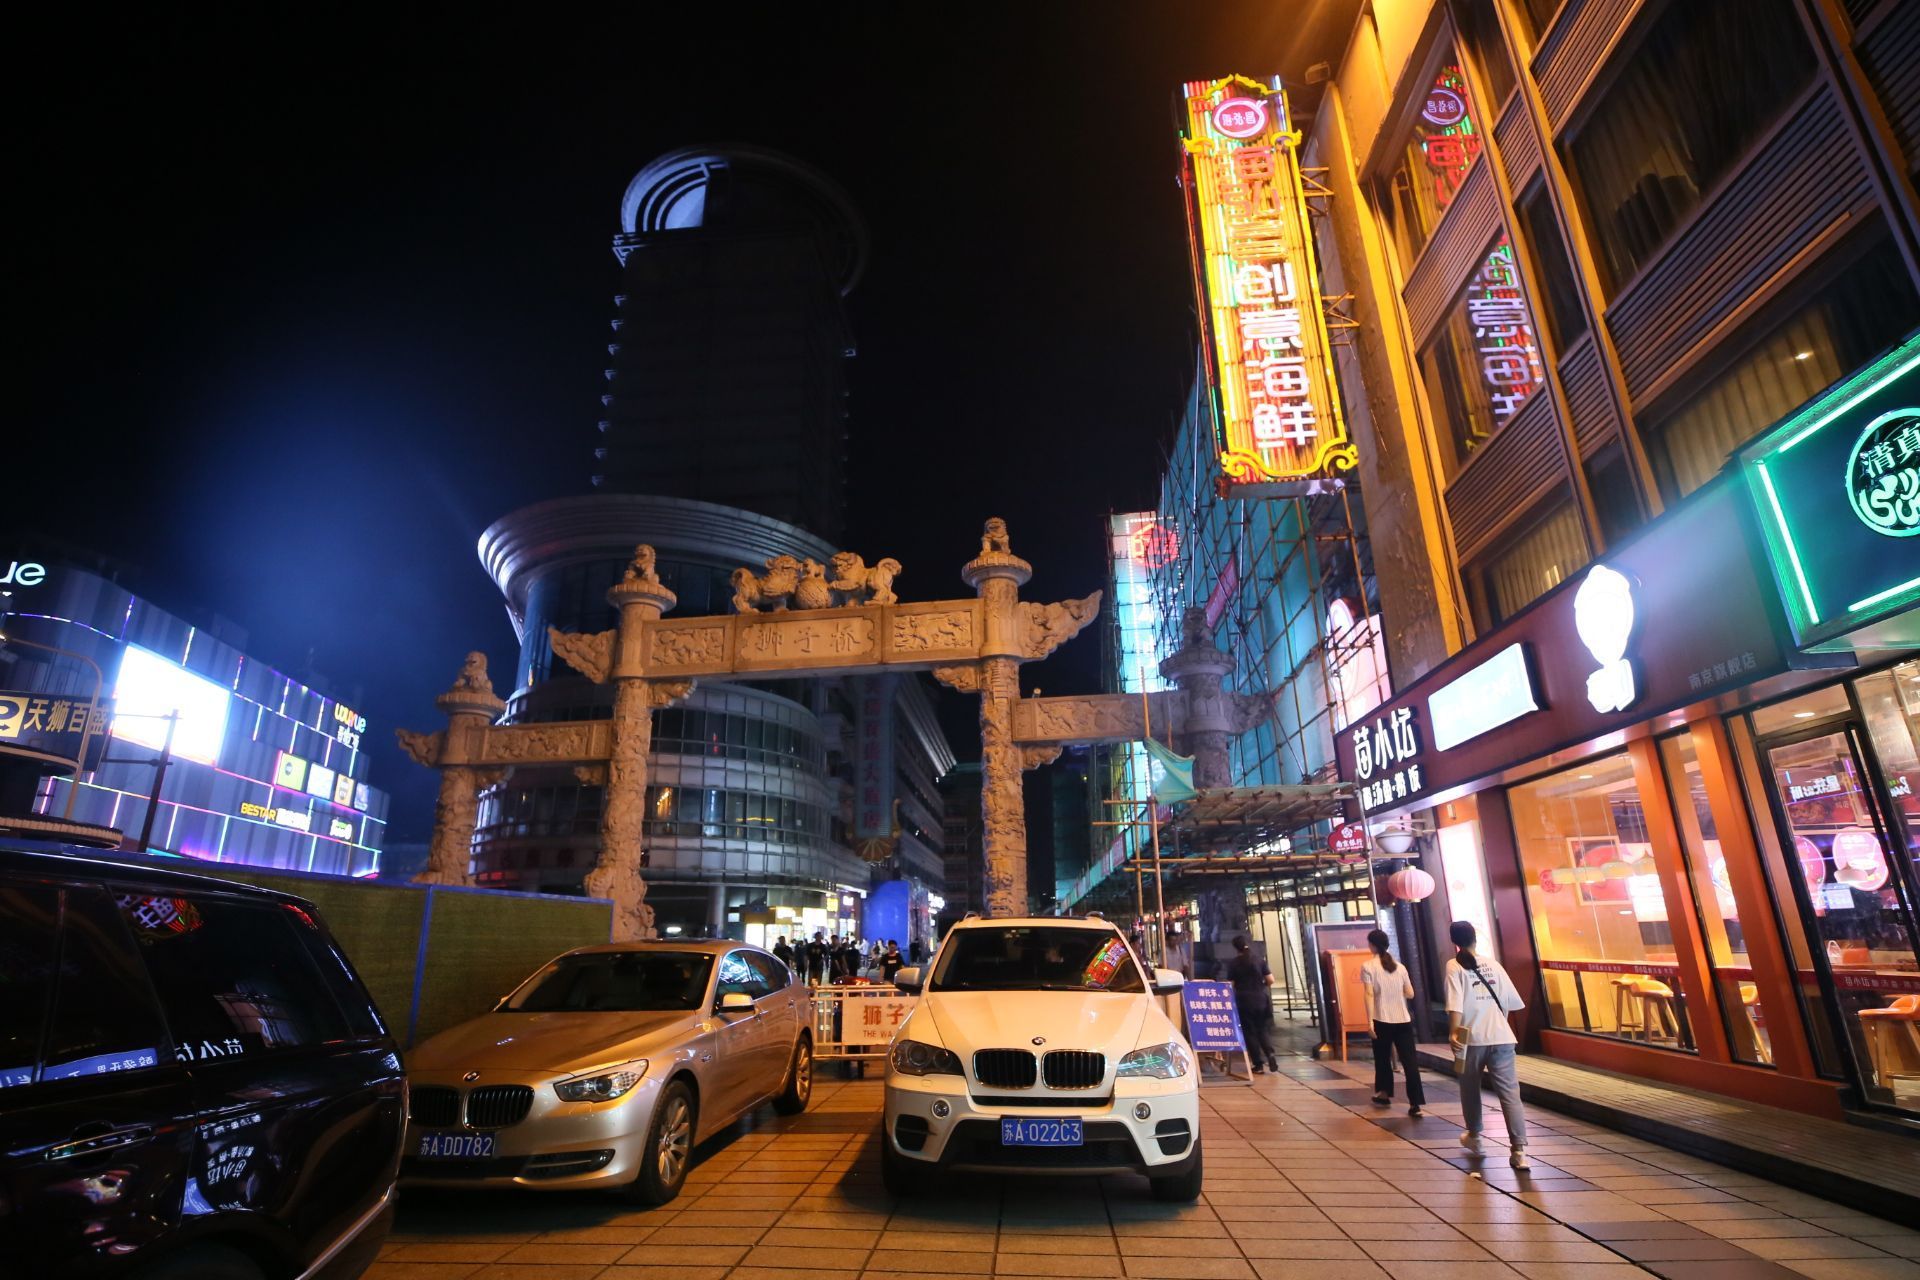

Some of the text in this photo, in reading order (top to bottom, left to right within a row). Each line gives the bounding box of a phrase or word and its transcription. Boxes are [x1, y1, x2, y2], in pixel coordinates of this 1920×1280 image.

[755, 621, 861, 657] 狮子桥
[1353, 707, 1417, 780] 苗小坛
[863, 1003, 915, 1025] 狮子
